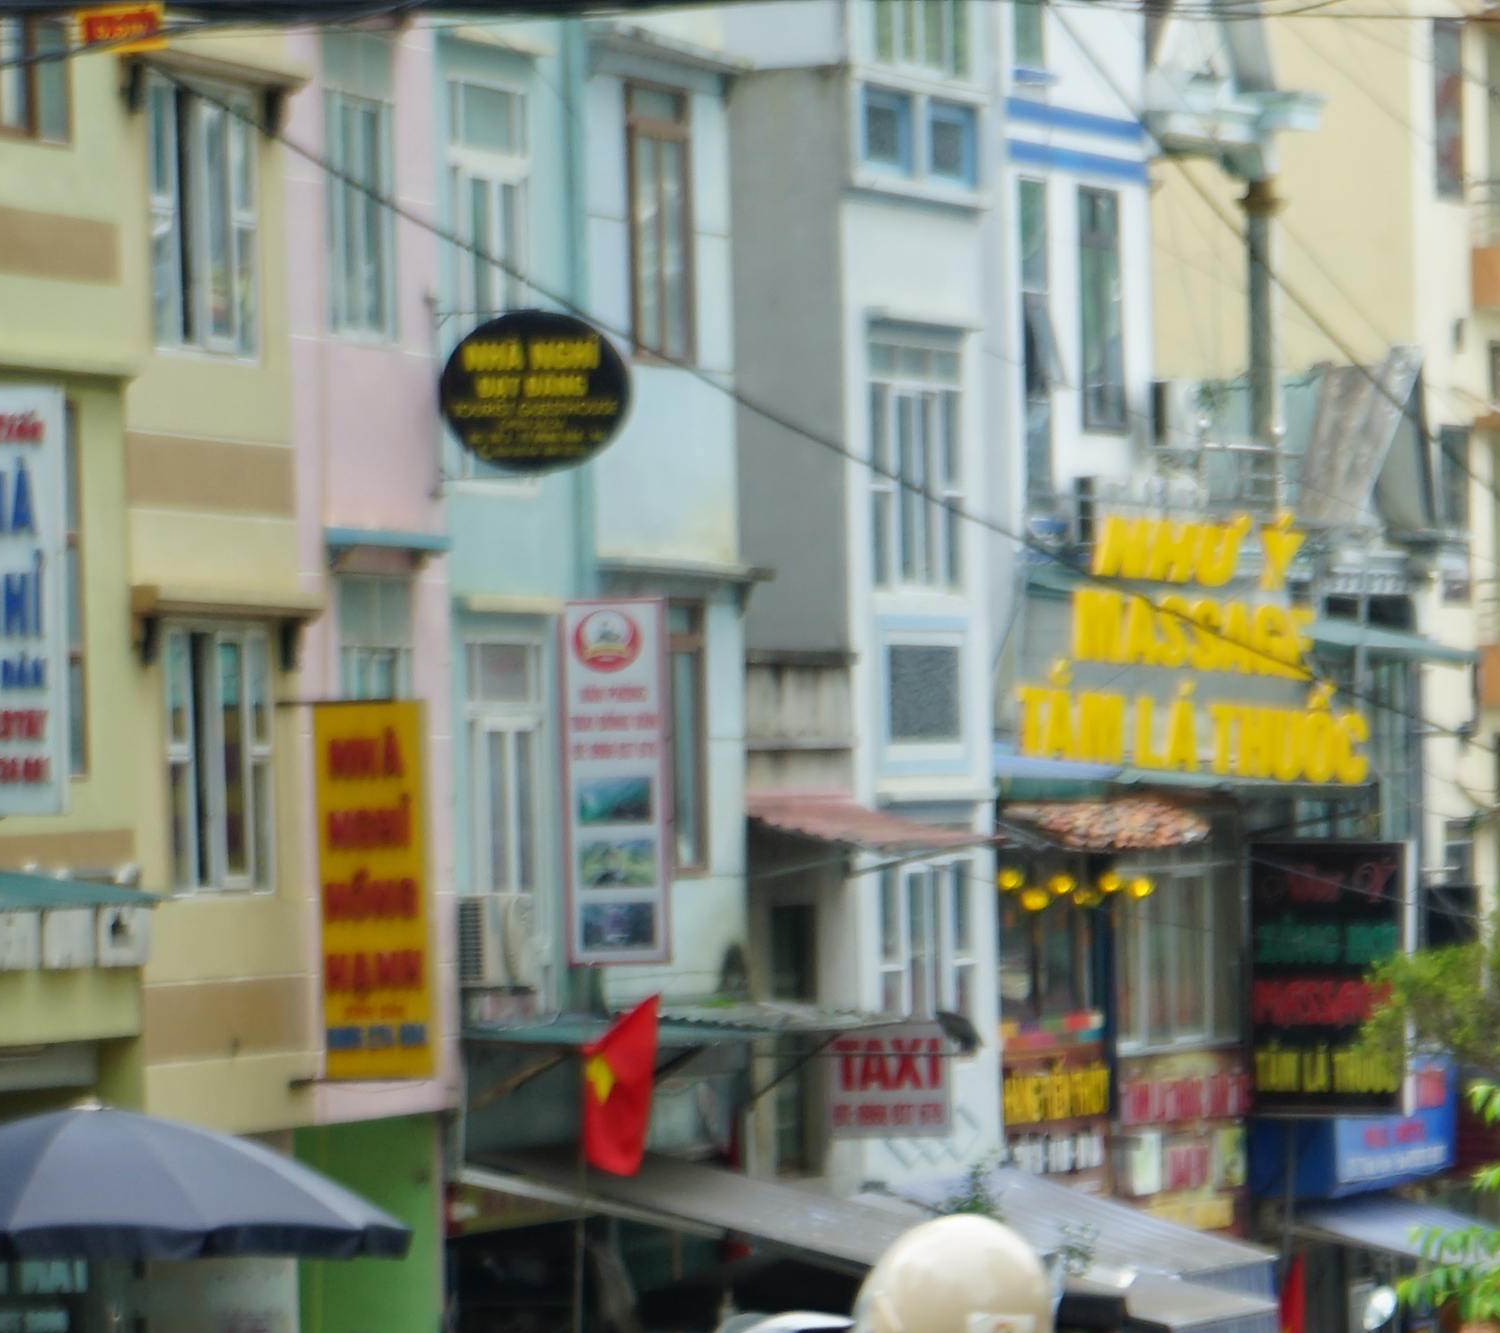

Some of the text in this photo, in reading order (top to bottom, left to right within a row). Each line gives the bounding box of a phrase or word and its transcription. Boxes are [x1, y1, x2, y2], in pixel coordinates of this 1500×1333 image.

[1073, 587, 1315, 681] MASSAGE
[1134, 680, 1198, 771] LÁ
[834, 1036, 942, 1092] TAXI
